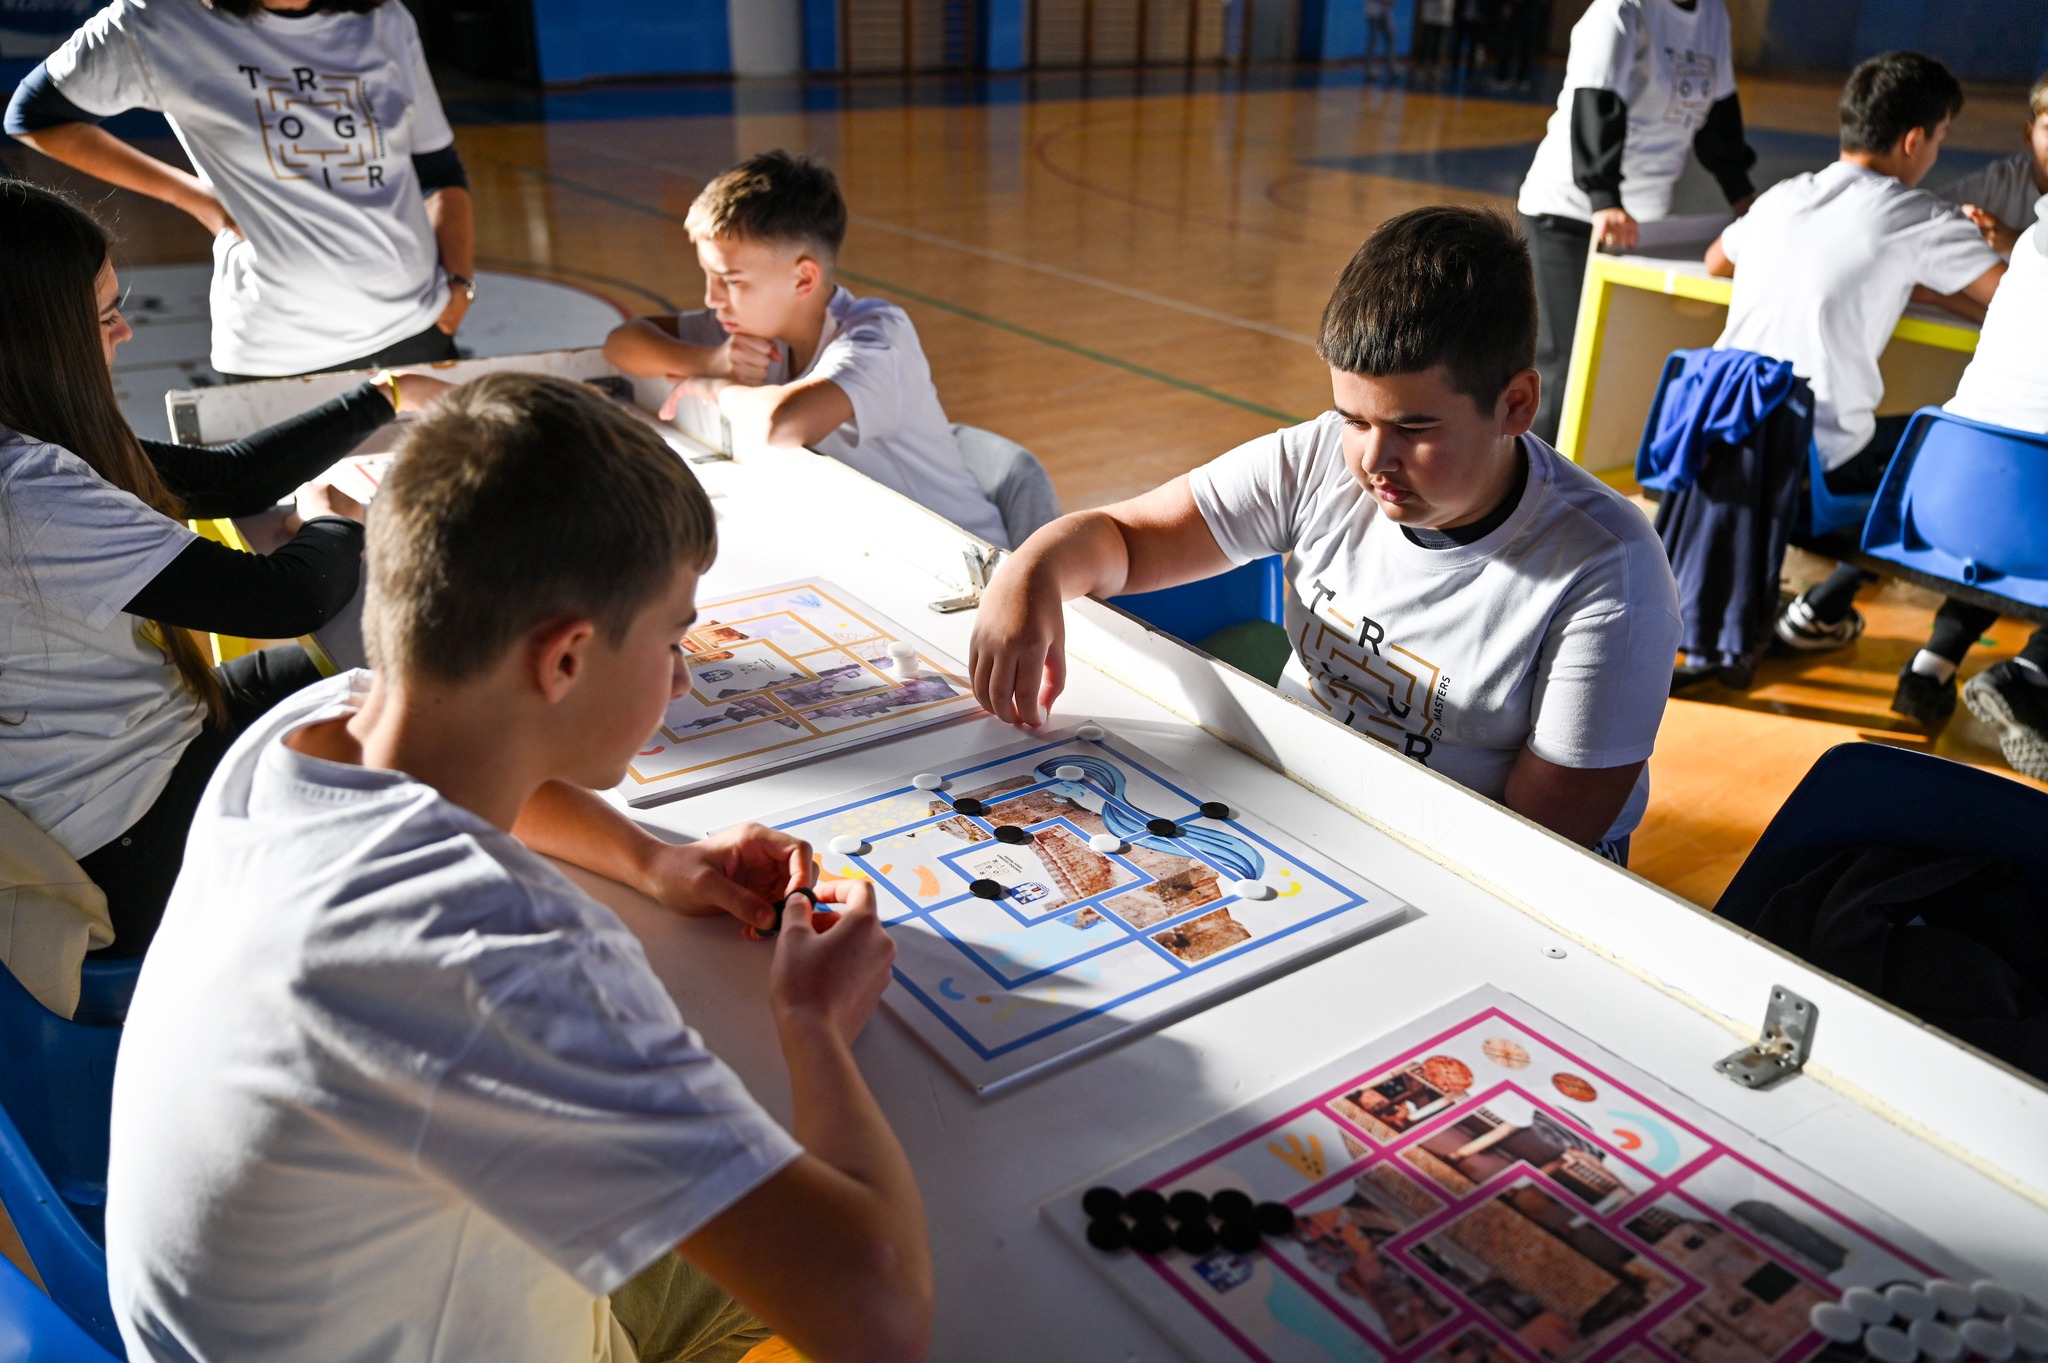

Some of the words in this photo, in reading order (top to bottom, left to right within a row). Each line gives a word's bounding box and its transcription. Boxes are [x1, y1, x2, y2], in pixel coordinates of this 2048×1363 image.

[238, 64, 261, 89] T
[292, 66, 317, 91] R
[334, 114, 356, 139] G
[367, 165, 385, 188] R
[1312, 579, 1336, 614] T
[1358, 616, 1385, 656] R
[1433, 675, 1451, 721] MASTERS
[1404, 732, 1433, 768] R
